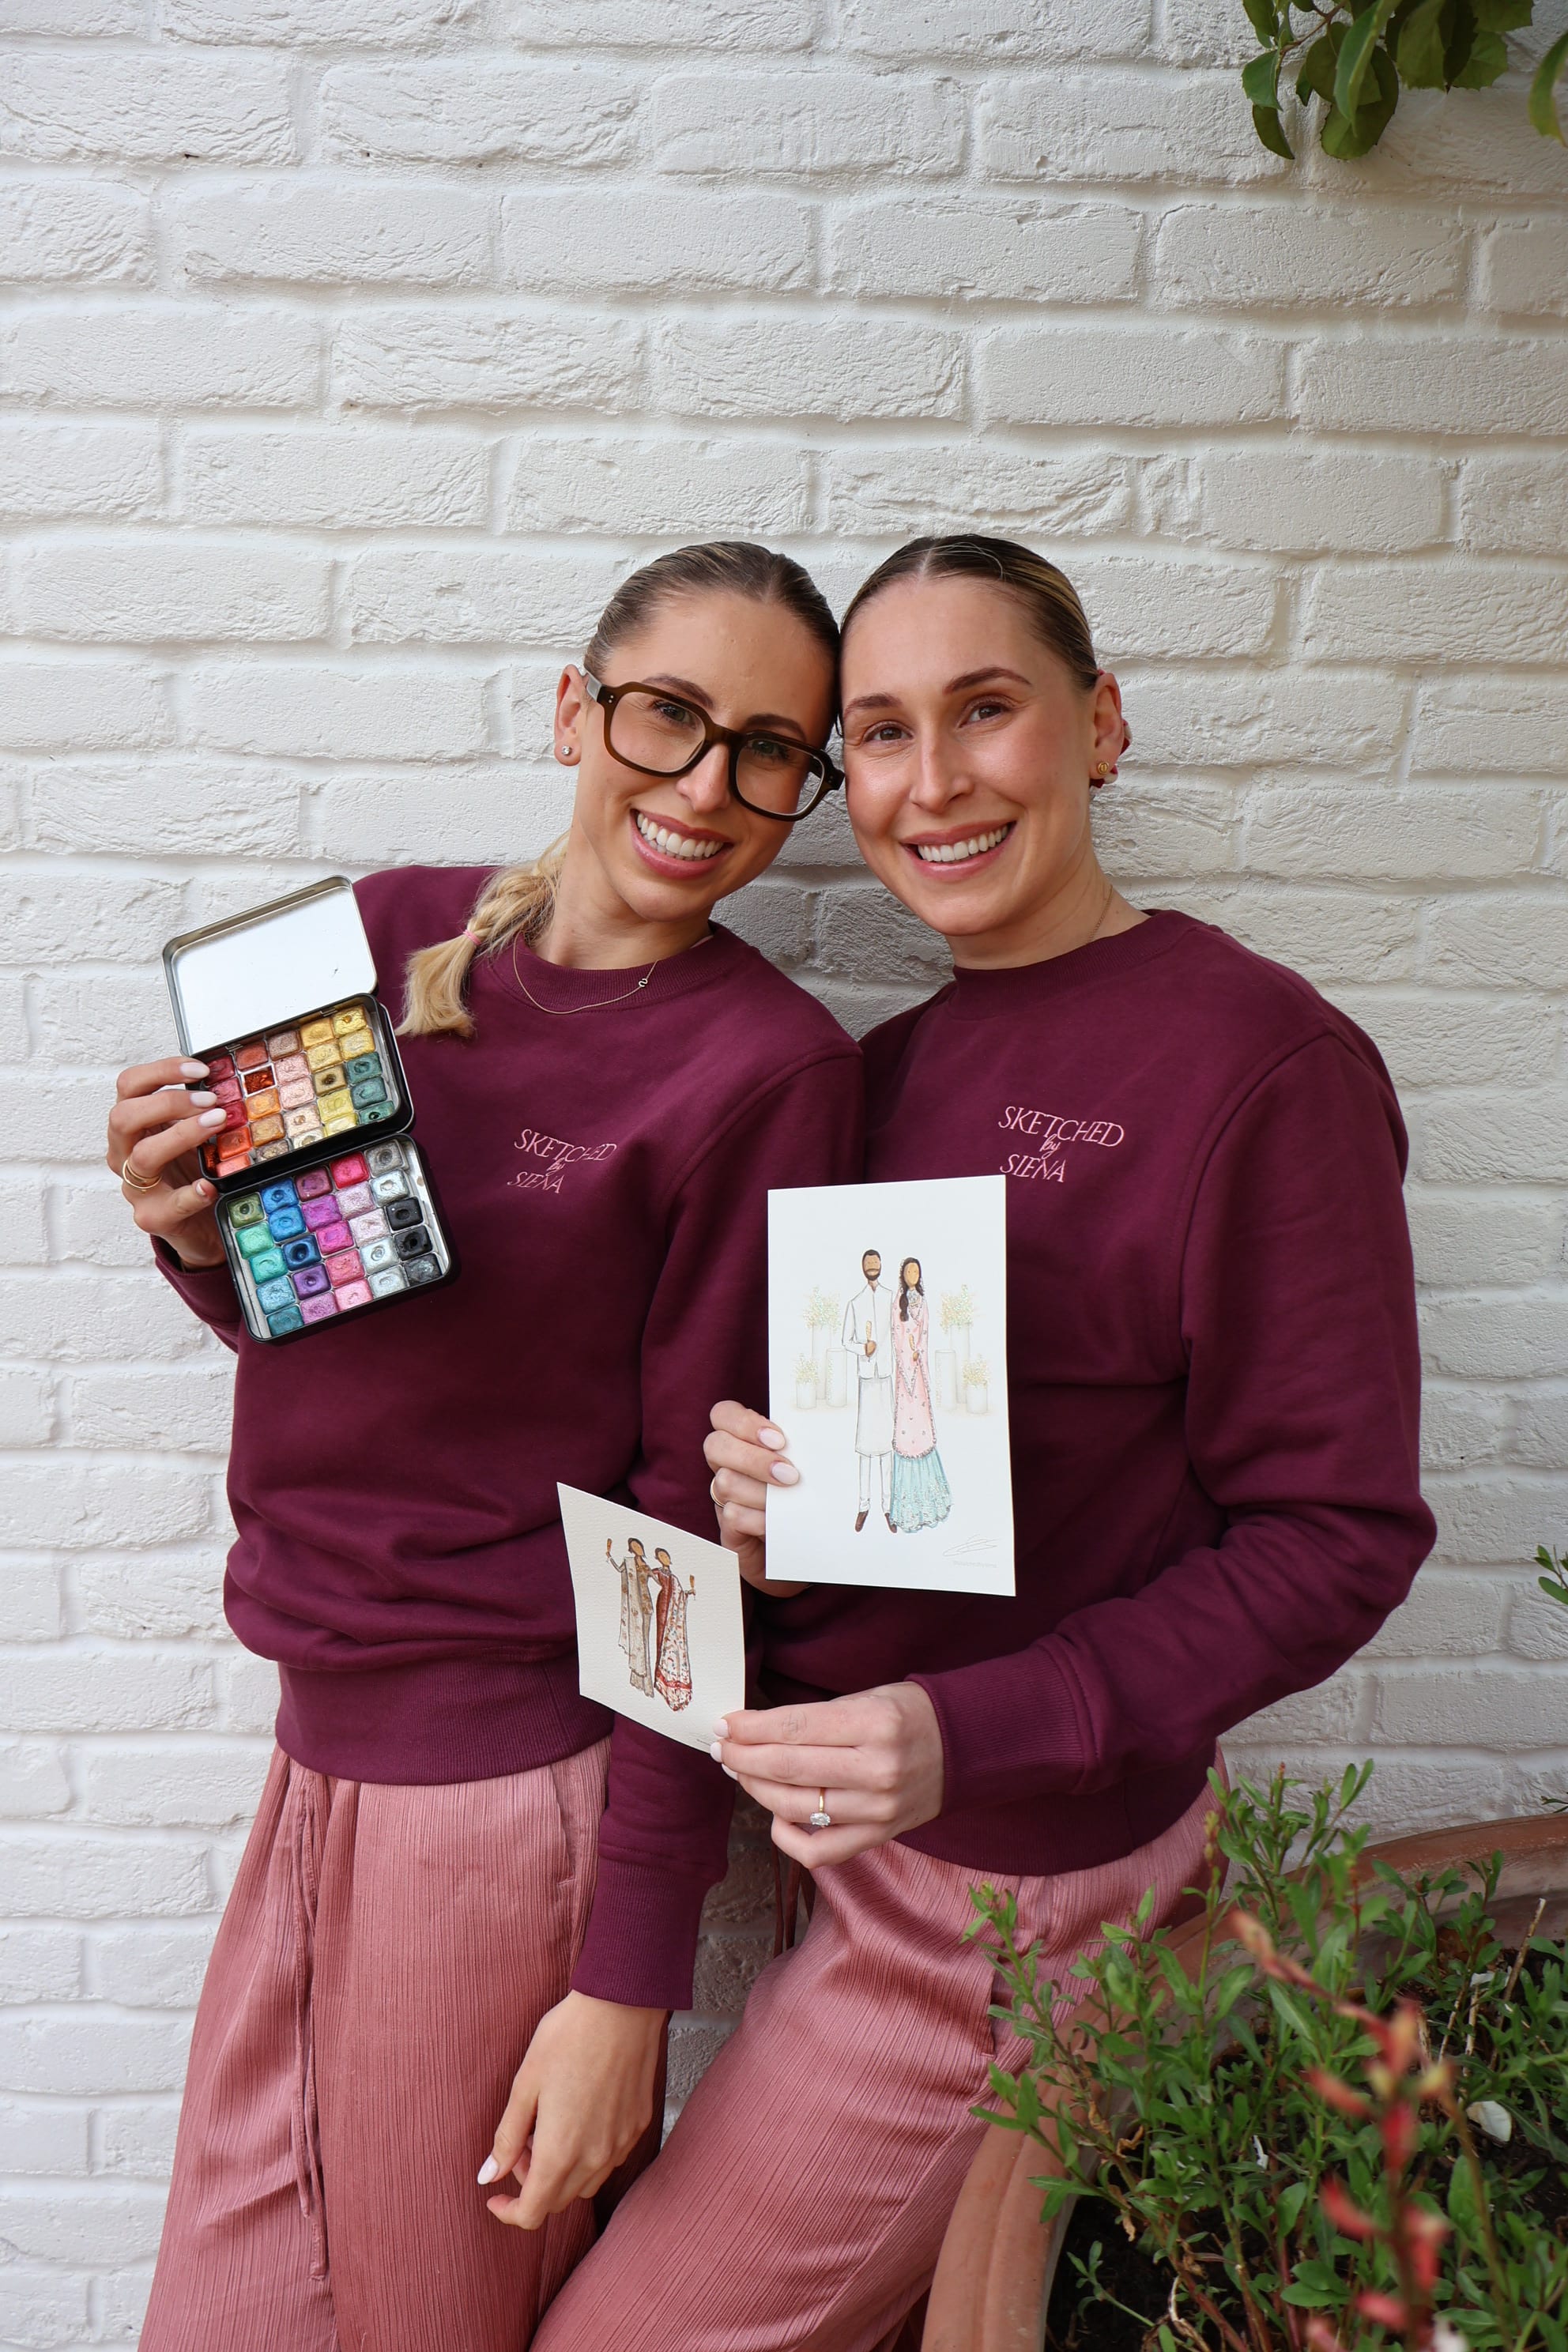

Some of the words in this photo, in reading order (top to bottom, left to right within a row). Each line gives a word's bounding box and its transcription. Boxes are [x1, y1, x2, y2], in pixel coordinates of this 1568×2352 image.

[998, 1106, 1125, 1147] SKETCHED
[514, 1129, 617, 1162] SKETCHED
[1039, 1133, 1061, 1160] by
[545, 1157, 566, 1177] by
[1000, 1153, 1067, 1182] SIENA
[507, 1171, 564, 1193] SIENA
